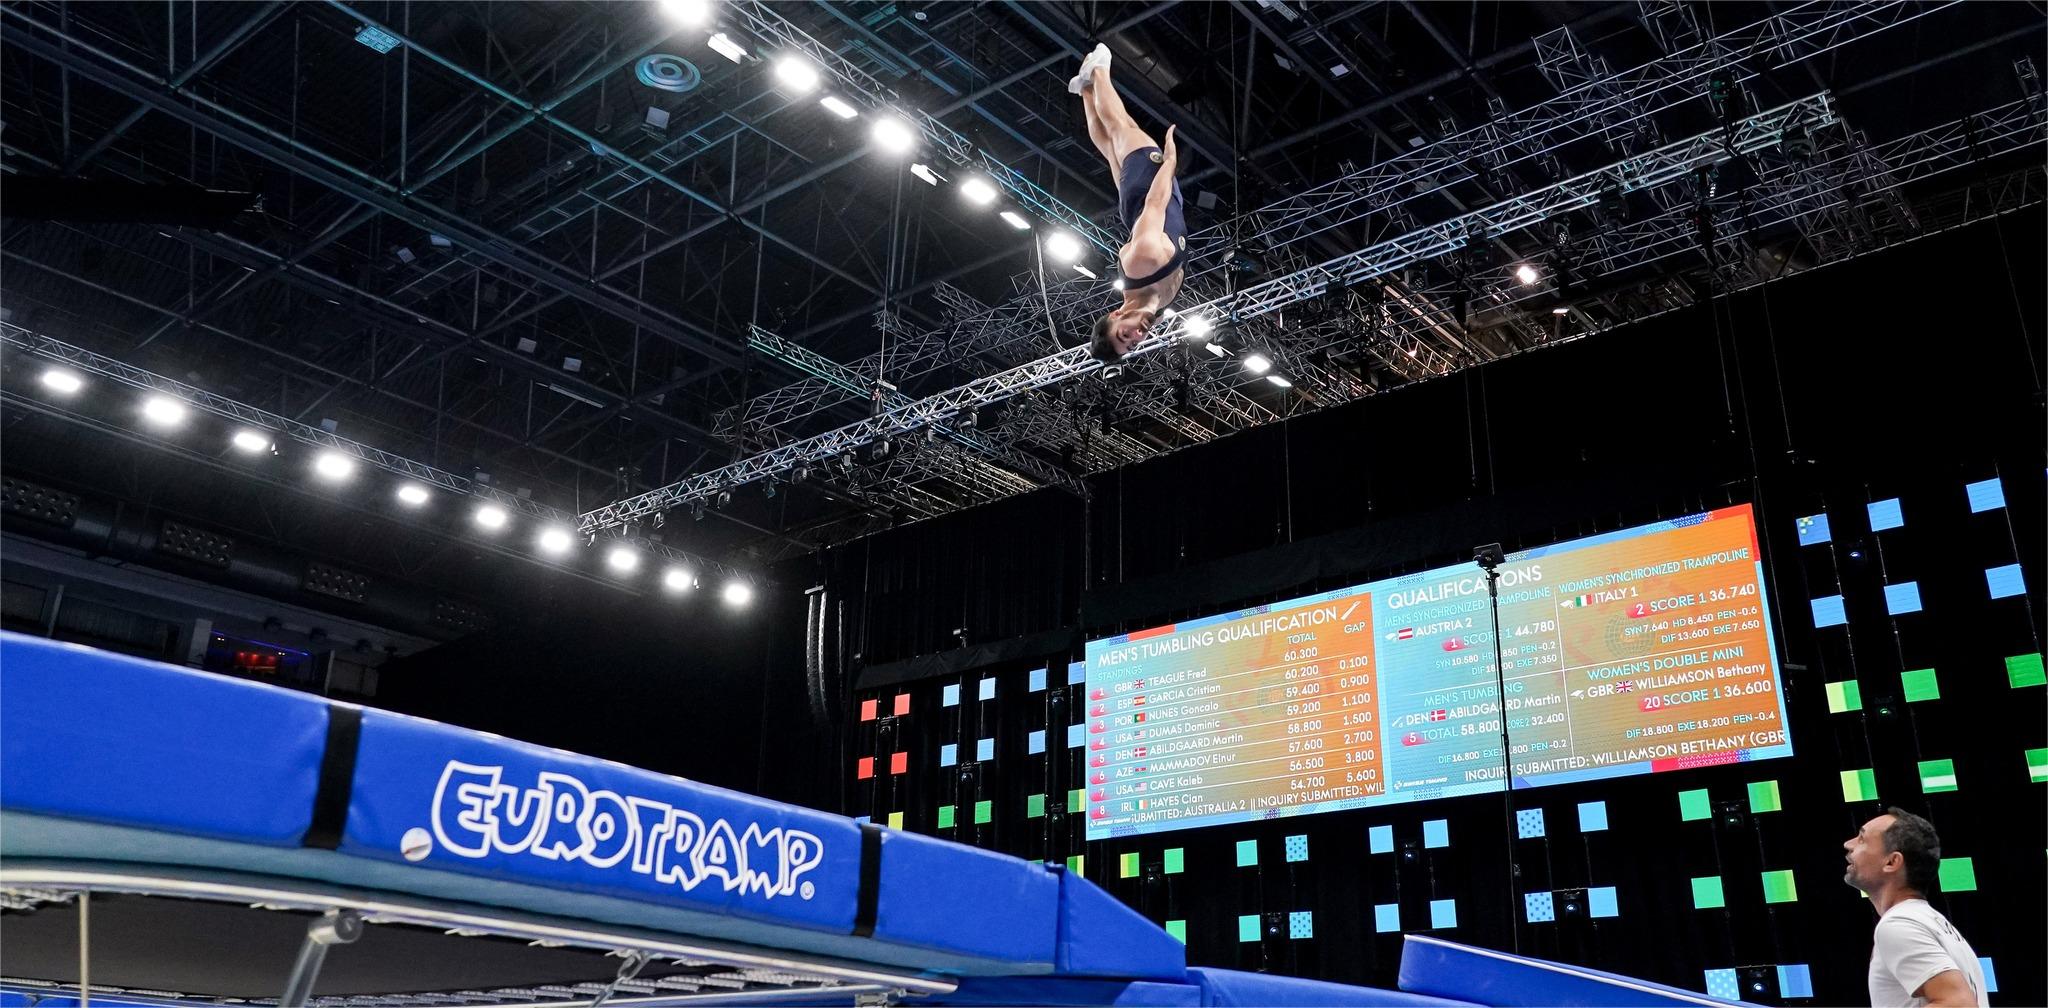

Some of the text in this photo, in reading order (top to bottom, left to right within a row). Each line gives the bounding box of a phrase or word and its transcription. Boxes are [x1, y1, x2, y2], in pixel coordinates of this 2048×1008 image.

[1558, 547, 1750, 594] WOMEN'S SYNCHRONIZED TRAMPOLINE
[1388, 565, 1542, 610] QUALIFICAIONS
[1594, 586, 1639, 604] ITALY 1
[1635, 583, 1756, 615] 2 SCORE 1 36.740
[1384, 613, 1412, 627] MEN'S
[1413, 600, 1485, 622] SYNCHRONIZED
[1415, 618, 1473, 637] AUSTRIA 2
[1624, 606, 1757, 636] SYN 7.640 HD 8.450 PEN -0.6
[1098, 606, 1337, 667] MEN'S TUMBLING QUALIFICATION
[1287, 622, 1366, 645] TOTAL GAP
[1451, 638, 1458, 648] 1
[1505, 628, 1512, 638] 1
[1515, 620, 1555, 636] 44.780
[1661, 620, 1760, 643] DIF 13.600 EXE 7.650
[1436, 658, 1450, 669] SYN
[1452, 654, 1479, 666] 10.580
[1482, 652, 1494, 661] HD
[1521, 644, 1537, 654] PEN
[1538, 641, 1556, 651] -0.2
[1471, 666, 1485, 676] DIF
[1517, 658, 1533, 668] EXE
[1533, 654, 1557, 665] 7.350
[1587, 646, 1744, 681] WOMEN'S DOUBLE MINI
[1098, 665, 1143, 681] STANDINGS
[1099, 647, 1318, 696] 1 GBR TEAGUE Fred 60.300
[1099, 656, 1368, 713] 2 ESP GARCIA Cristian 60.200 0.100
[1587, 663, 1766, 698] GBR WILLIAMSON Bethany
[1099, 674, 1369, 729] 3 POR NUNES Goncalo 59.400 0.900
[1406, 694, 1561, 726] DEN ABILDGARD Martin
[1424, 693, 1458, 708] MEN'S
[1644, 680, 1771, 709] 20 SCORE 1 36.600
[1099, 693, 1370, 746] 4 USA DUMAS Dominic 59.200 1.100
[1409, 732, 1416, 743] 5
[1421, 728, 1458, 741] TOTAL
[1461, 720, 1500, 736] 58.800
[1531, 713, 1564, 726] 32.400
[1626, 711, 1775, 739] DIF 18.800 EXE 18.200 PEN -0.4
[1099, 711, 1372, 763] 5 DEN ABILDGAARD Martin 58.800 1.500
[1439, 755, 1451, 764] DIF
[1452, 751, 1479, 762] 16.800
[1483, 749, 1498, 758] EXE
[1531, 741, 1548, 752] PEN
[1549, 739, 1567, 749] -0.2
[1516, 755, 1590, 775] SUBMITTED:
[1593, 743, 1678, 766] WILLIAMSON
[1681, 735, 1746, 754] BETHANY
[1749, 729, 1785, 747] (GBR
[1099, 731, 1373, 780] 6 AZE MAMMADOV Elnur 57.600 2.700
[1099, 750, 1374, 797] 7 USA CAVE Kaleb 56.500 3.800
[1100, 769, 1376, 815] 8 IRL HAYES Cian 54.700 5.600
[1184, 801, 1238, 817] AUSTRALIA
[1240, 800, 1246, 810] 2
[1258, 793, 1299, 808] INQUIRY
[1301, 786, 1363, 802] SUBMITTED:
[1365, 782, 1385, 793] WIL
[431, 760, 823, 899] EUROTRAMP
